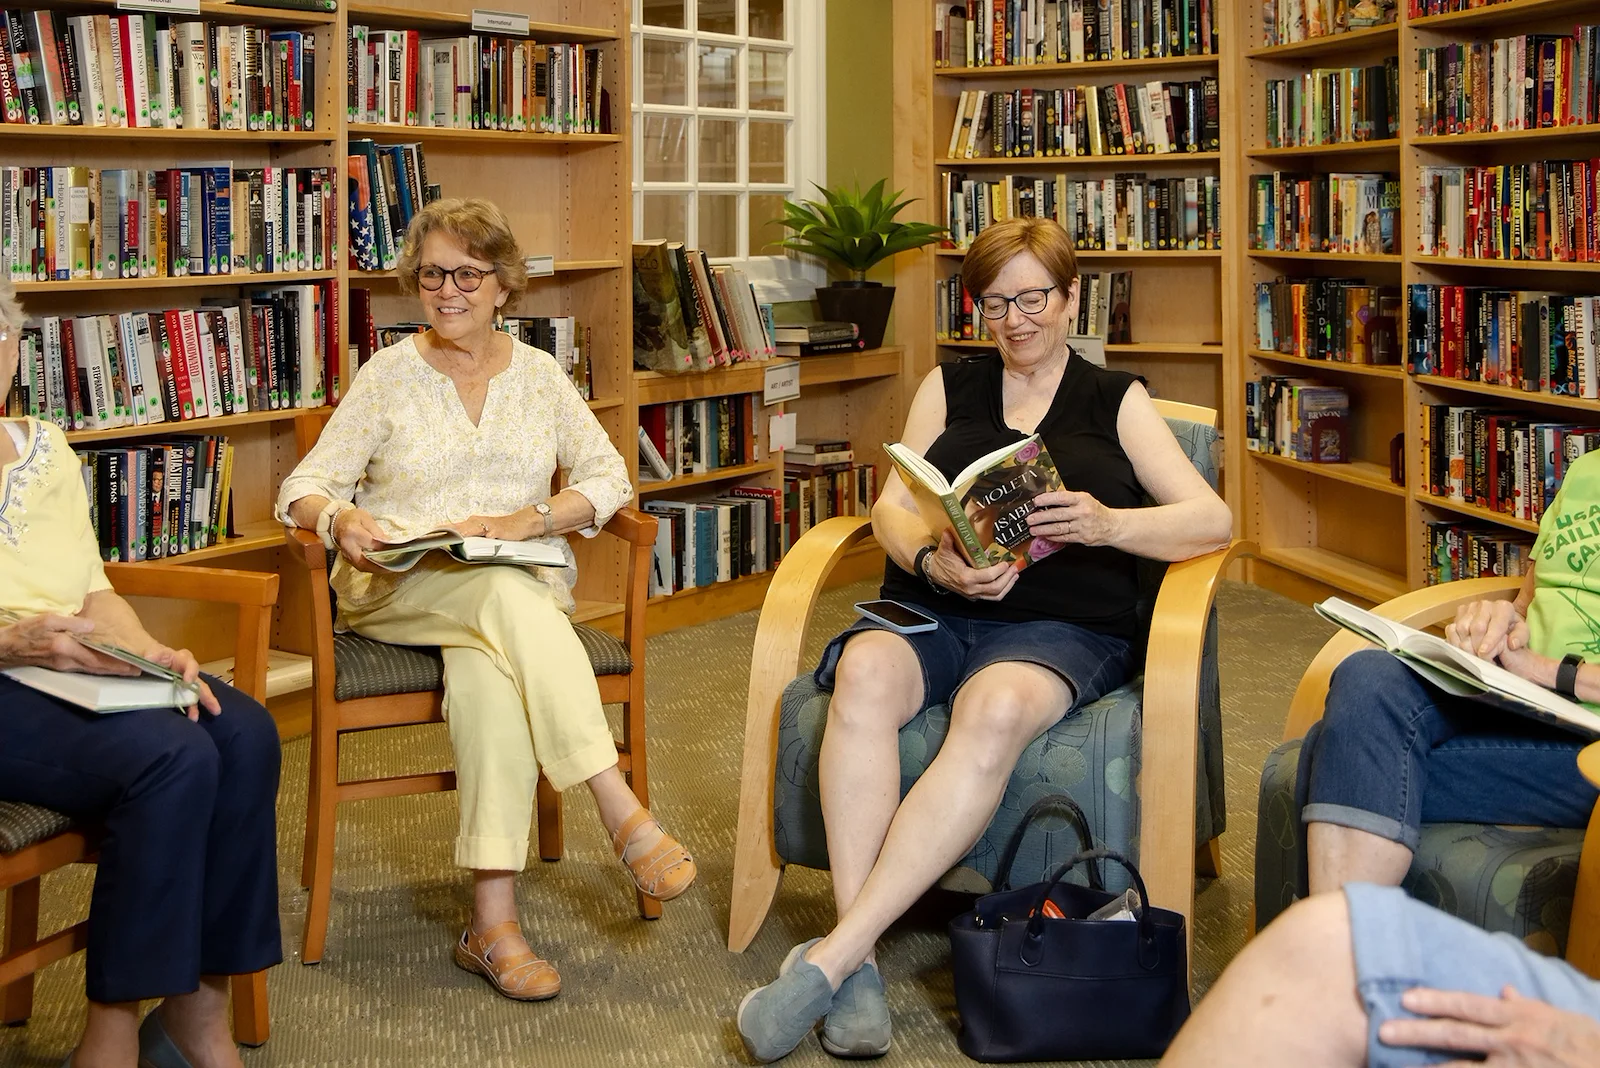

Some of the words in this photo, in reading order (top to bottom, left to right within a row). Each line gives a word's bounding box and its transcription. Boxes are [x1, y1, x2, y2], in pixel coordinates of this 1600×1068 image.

[10, 17, 22, 49] BROKAW
[17, 24, 26, 41] TOM
[134, 22, 142, 42] BILL
[487, 18, 512, 26] International
[245, 28, 256, 79] GOLDWATER
[994, 24, 1004, 58] EMPIRE
[136, 43, 144, 76] BRYSON
[230, 36, 238, 90] Hometown
[0, 63, 12, 105] BROKE
[139, 79, 146, 90] AT
[1577, 80, 1585, 97] play
[265, 173, 272, 183] MY
[408, 168, 417, 199] PYRAMIDS
[1574, 166, 1582, 193] ROBIN
[57, 183, 65, 209] HERBAL
[180, 197, 188, 211] BATTLE
[1575, 193, 1583, 219] COOK
[180, 212, 188, 220] CRY
[58, 210, 66, 254] DRUGSTORE
[180, 226, 188, 246] FREEDOM
[1514, 237, 1520, 246] ME
[159, 319, 168, 342] FEAR
[183, 314, 193, 331] BOB
[216, 315, 225, 339] FEAR
[266, 308, 275, 329] EVERY
[67, 338, 75, 362] AMERICA
[127, 321, 135, 357] OPERATION
[174, 330, 184, 372] WOODWARD
[268, 330, 276, 347] KNEE
[165, 357, 173, 373] BOB
[185, 331, 200, 377] WOODWARD
[220, 352, 228, 370] BOB
[269, 347, 277, 370] SHALL
[1568, 349, 1576, 366] BACK
[234, 356, 242, 382] Leveling
[1578, 347, 1586, 388] CRICHTO
[167, 374, 180, 417] WOODWARD
[210, 370, 218, 405] WOODWAR
[222, 371, 232, 411] WOODWRD
[770, 382, 778, 390] ART
[781, 379, 793, 388] ARTIST
[169, 448, 184, 501] CATASTROPHE
[185, 466, 194, 493] CULTURE
[109, 481, 118, 503] 1968
[734, 489, 772, 499] Eleanor
[976, 469, 1038, 509] VIOLETA
[945, 499, 961, 520] ISABEL
[957, 521, 975, 547] ALLENDE
[994, 497, 1038, 532] ISABE
[1556, 503, 1600, 530] USA
[995, 518, 1029, 545] ALLE
[1543, 515, 1600, 560] SAILI
[1567, 541, 1600, 573] CA
